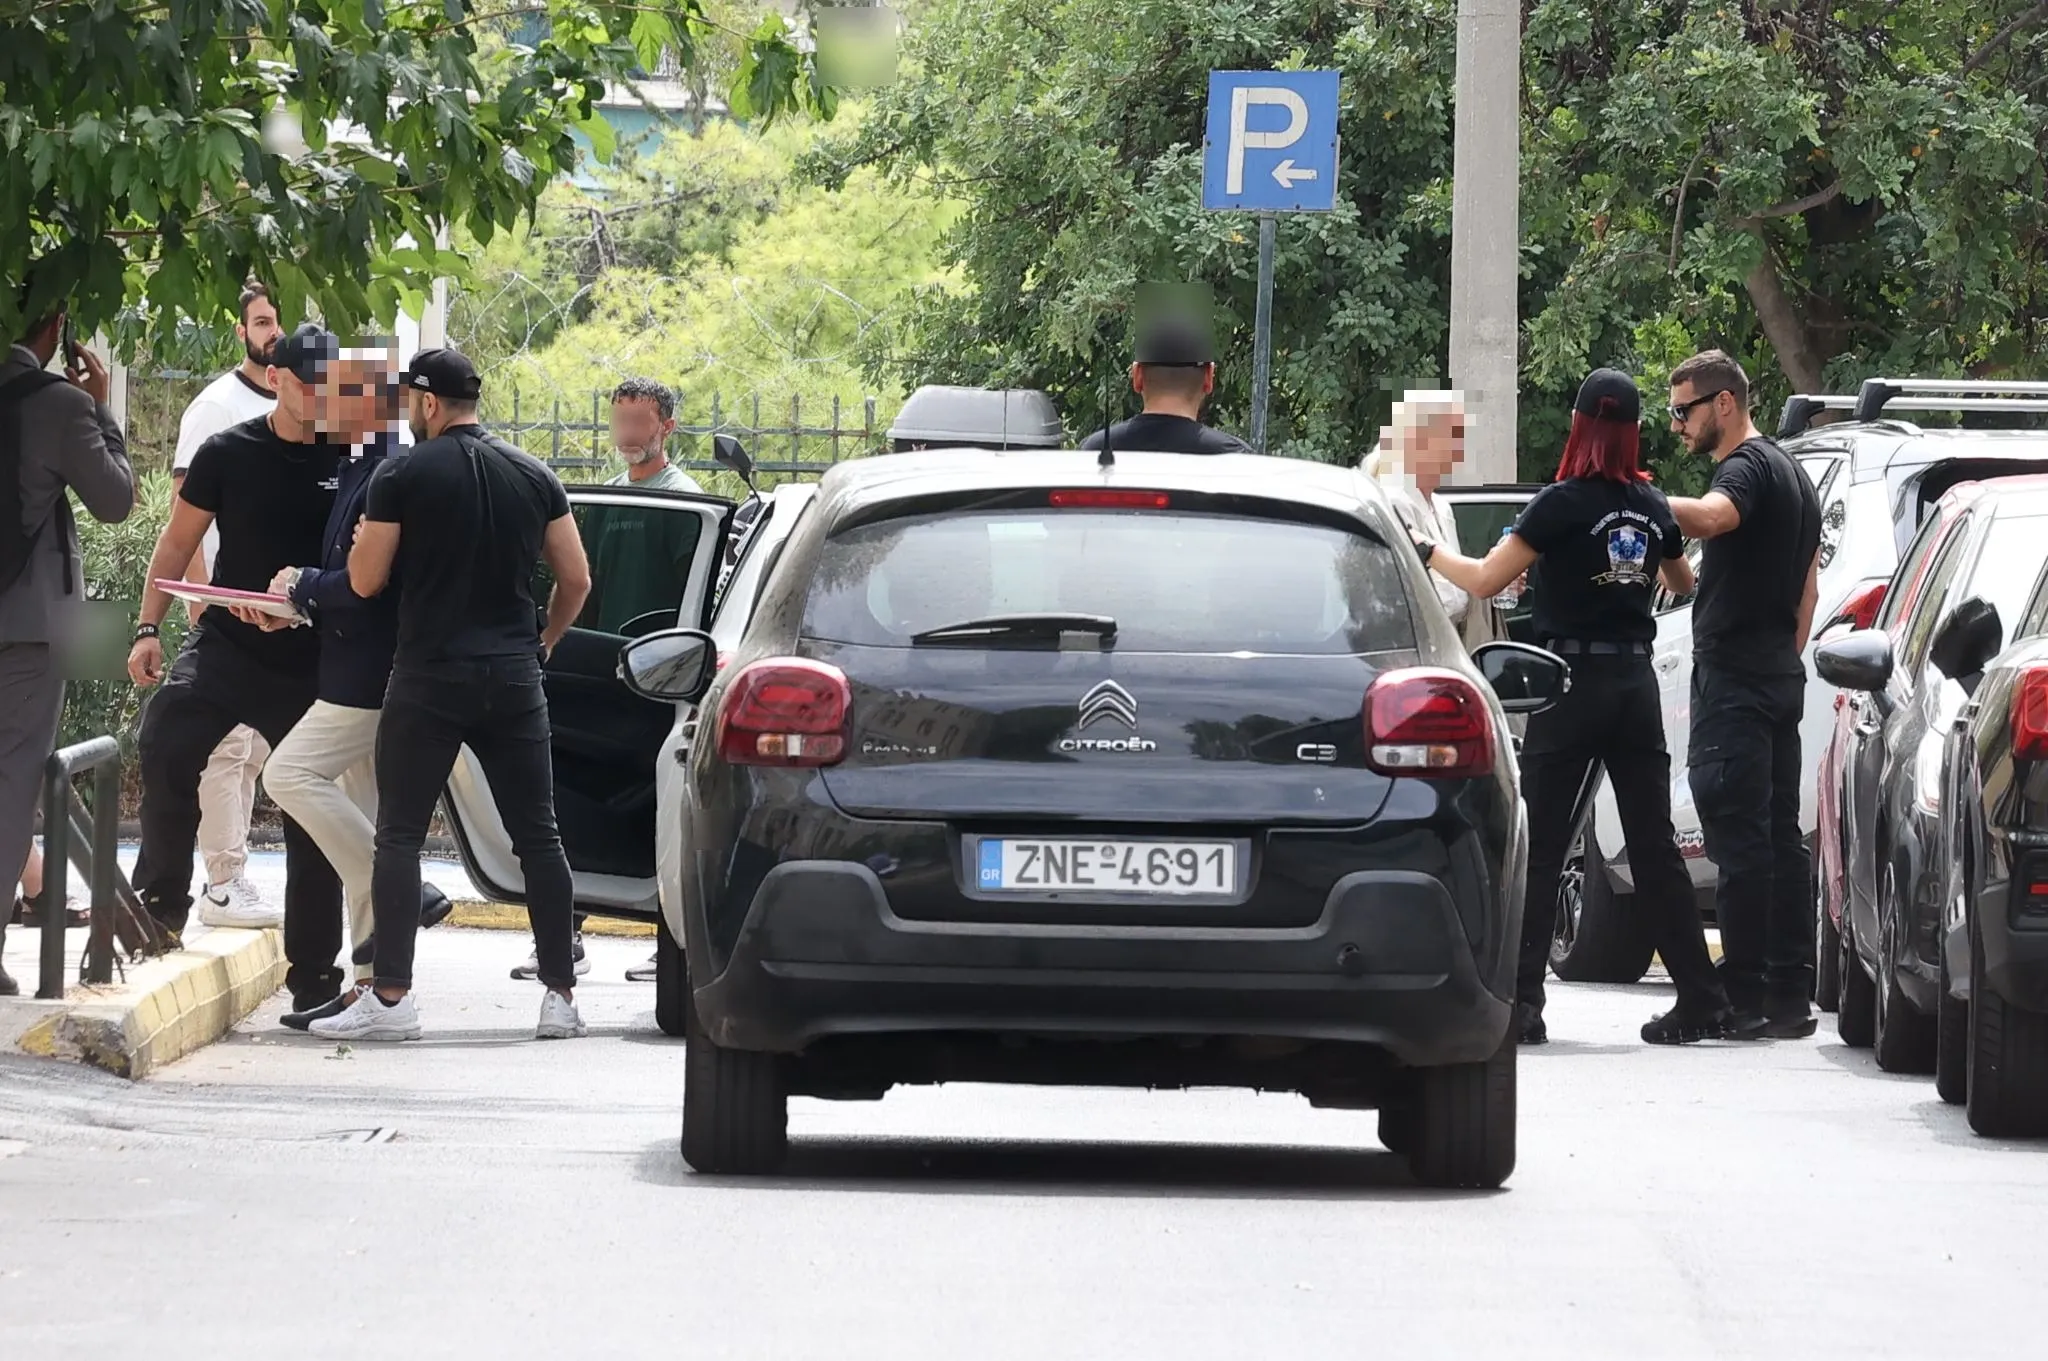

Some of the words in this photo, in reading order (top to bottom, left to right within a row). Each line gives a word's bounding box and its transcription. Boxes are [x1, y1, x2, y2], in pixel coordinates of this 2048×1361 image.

[1226, 87, 1309, 195] P
[1296, 743, 1337, 761] C3
[981, 868, 1000, 880] GR
